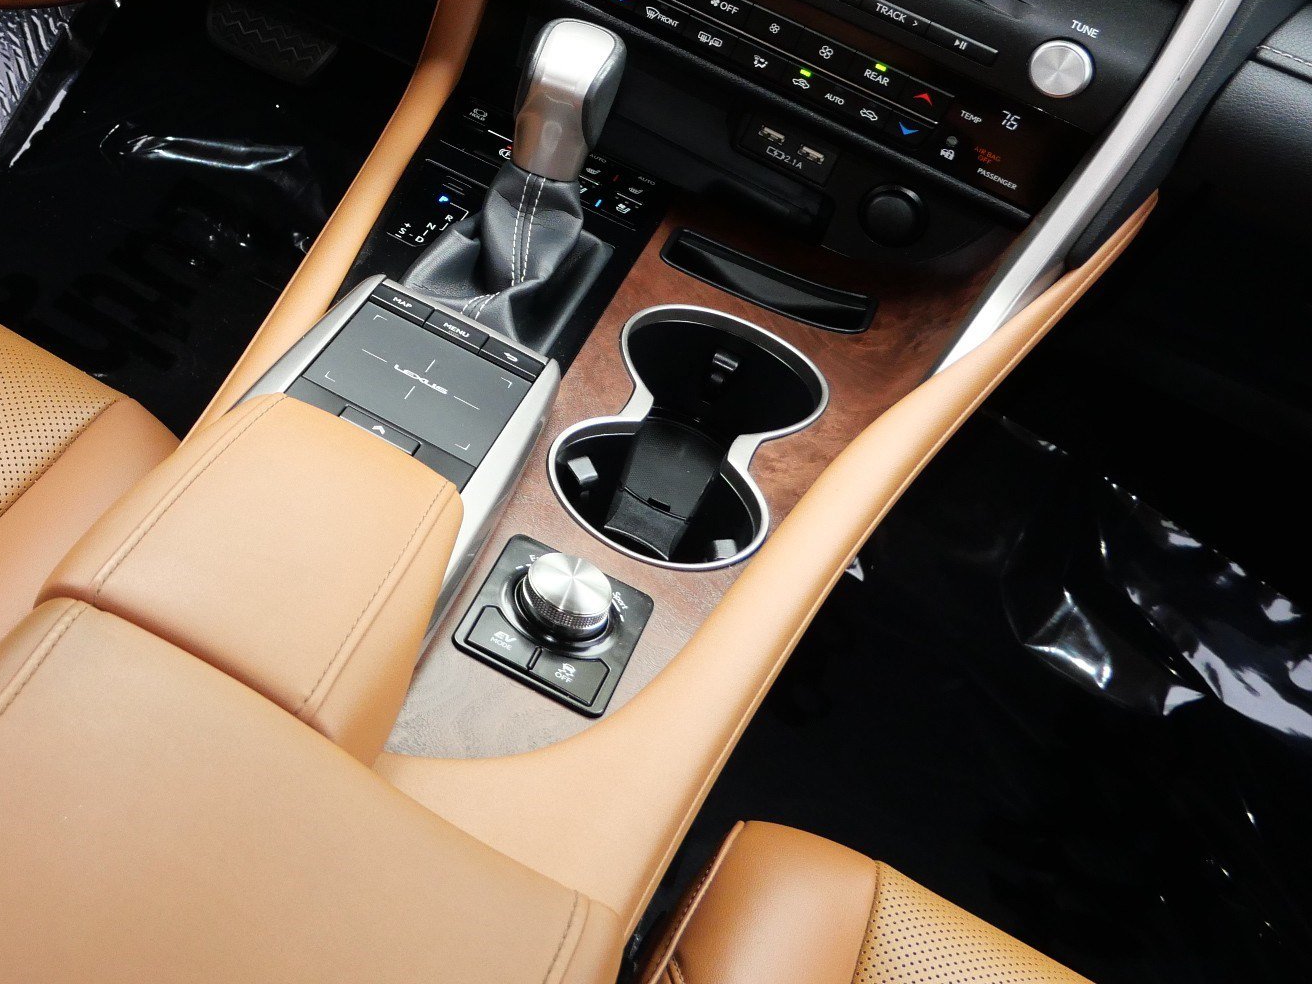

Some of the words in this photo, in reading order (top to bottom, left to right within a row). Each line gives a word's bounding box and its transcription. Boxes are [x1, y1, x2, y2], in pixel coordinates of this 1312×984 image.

[720, 1, 739, 15] OFF
[875, 2, 907, 24] TRACK
[657, 13, 680, 28] FRONT
[1070, 19, 1100, 39] TUNE
[864, 68, 890, 87] REAR
[824, 92, 845, 106] AUTO
[960, 109, 982, 124] TEMP
[1001, 110, 1021, 130] 76
[589, 154, 607, 164] AUTO
[784, 154, 803, 170] 2.1A
[987, 151, 1001, 163] BAG
[637, 176, 656, 186] AUTO
[977, 167, 1018, 190] PASSENGER
[444, 214, 454, 223] R
[398, 227, 407, 235] S
[426, 222, 437, 231] N
[414, 235, 425, 243] D
[392, 296, 413, 309] MAP
[442, 322, 470, 338] MENU
[393, 363, 449, 395] LEXUS
[612, 591, 629, 610] Sport
[490, 636, 513, 651] MODE
[494, 630, 517, 643] EV
[554, 670, 574, 684] OFF
